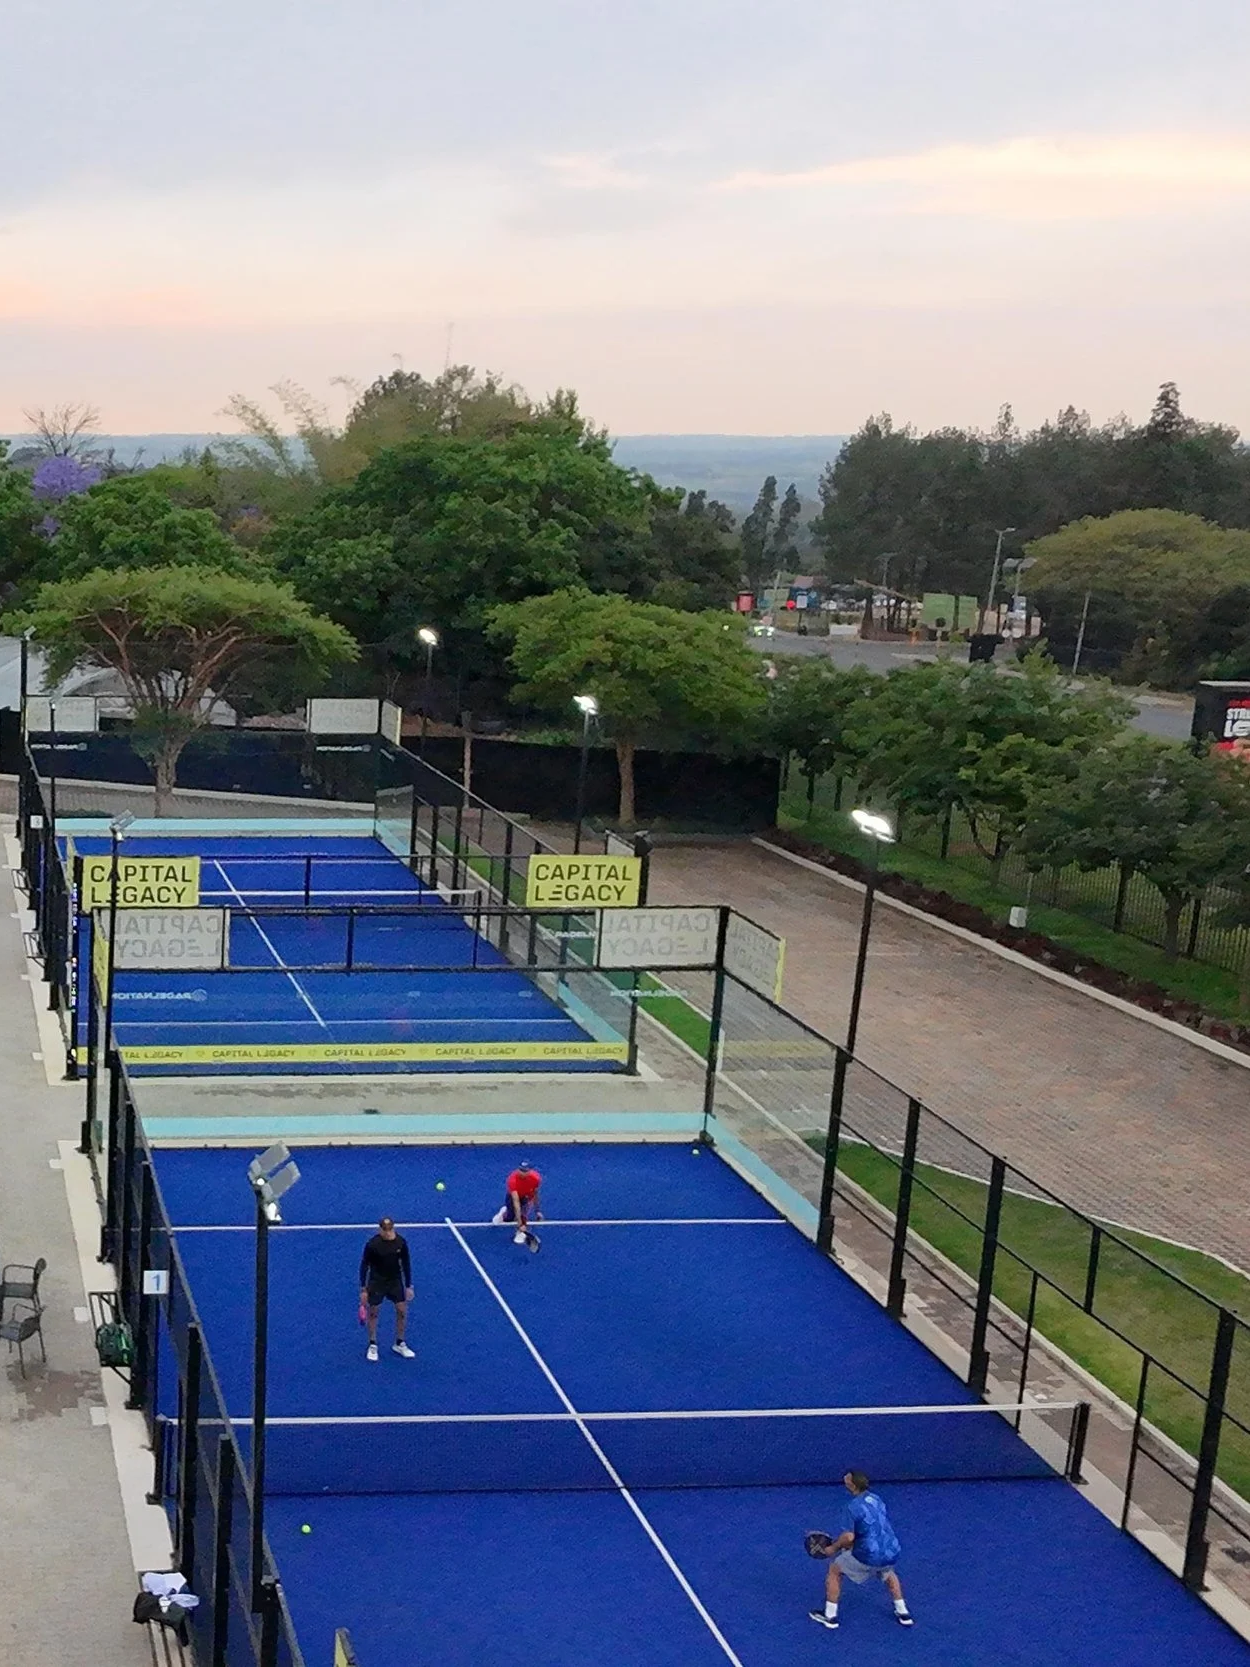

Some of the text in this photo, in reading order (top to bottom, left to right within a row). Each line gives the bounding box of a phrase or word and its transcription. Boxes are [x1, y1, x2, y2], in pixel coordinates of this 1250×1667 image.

[91, 865, 192, 883] CAPITAL
[535, 863, 633, 881] CAPITAL
[534, 884, 627, 901] LEGACY
[152, 1274, 160, 1291] 1
